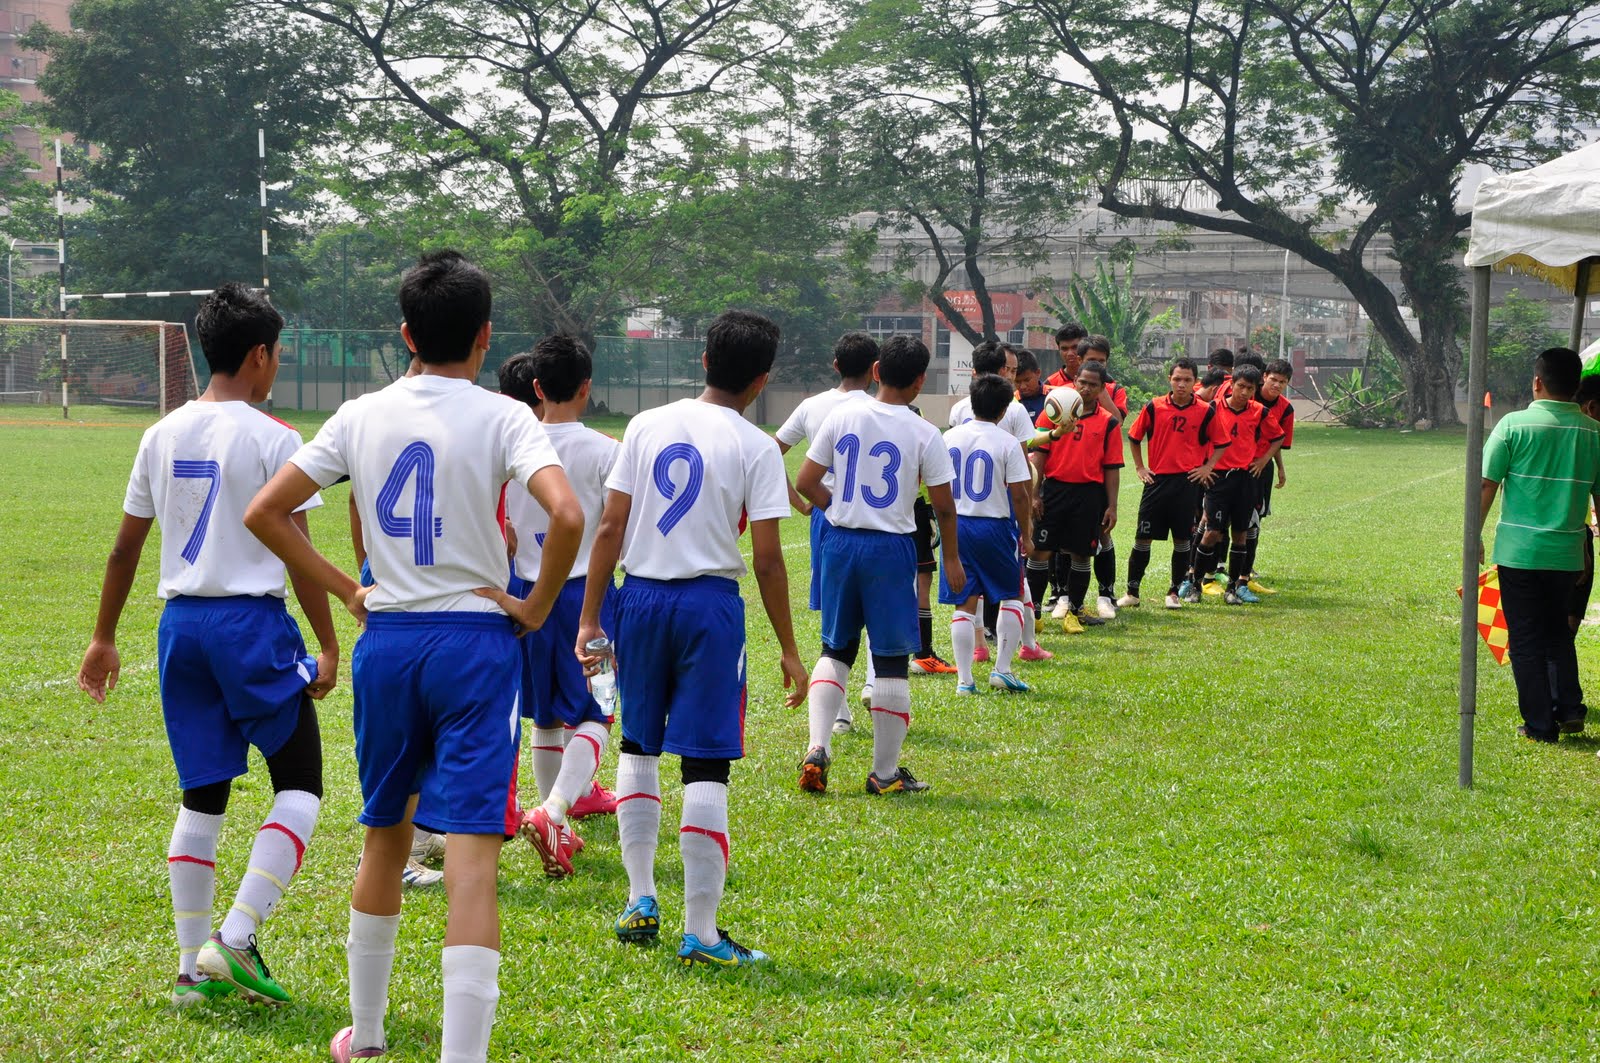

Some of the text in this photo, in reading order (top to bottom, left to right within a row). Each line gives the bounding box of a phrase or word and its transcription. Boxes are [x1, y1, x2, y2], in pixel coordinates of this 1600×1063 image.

[1172, 415, 1187, 433] 12
[1231, 422, 1239, 438] 4
[653, 443, 704, 536] 9
[834, 433, 902, 509] 13
[948, 447, 994, 503] 10
[173, 460, 221, 565] 7
[376, 441, 442, 566] 4
[1215, 510, 1223, 523] 4
[1038, 529, 1049, 543] 9
[1139, 520, 1151, 534] 12
